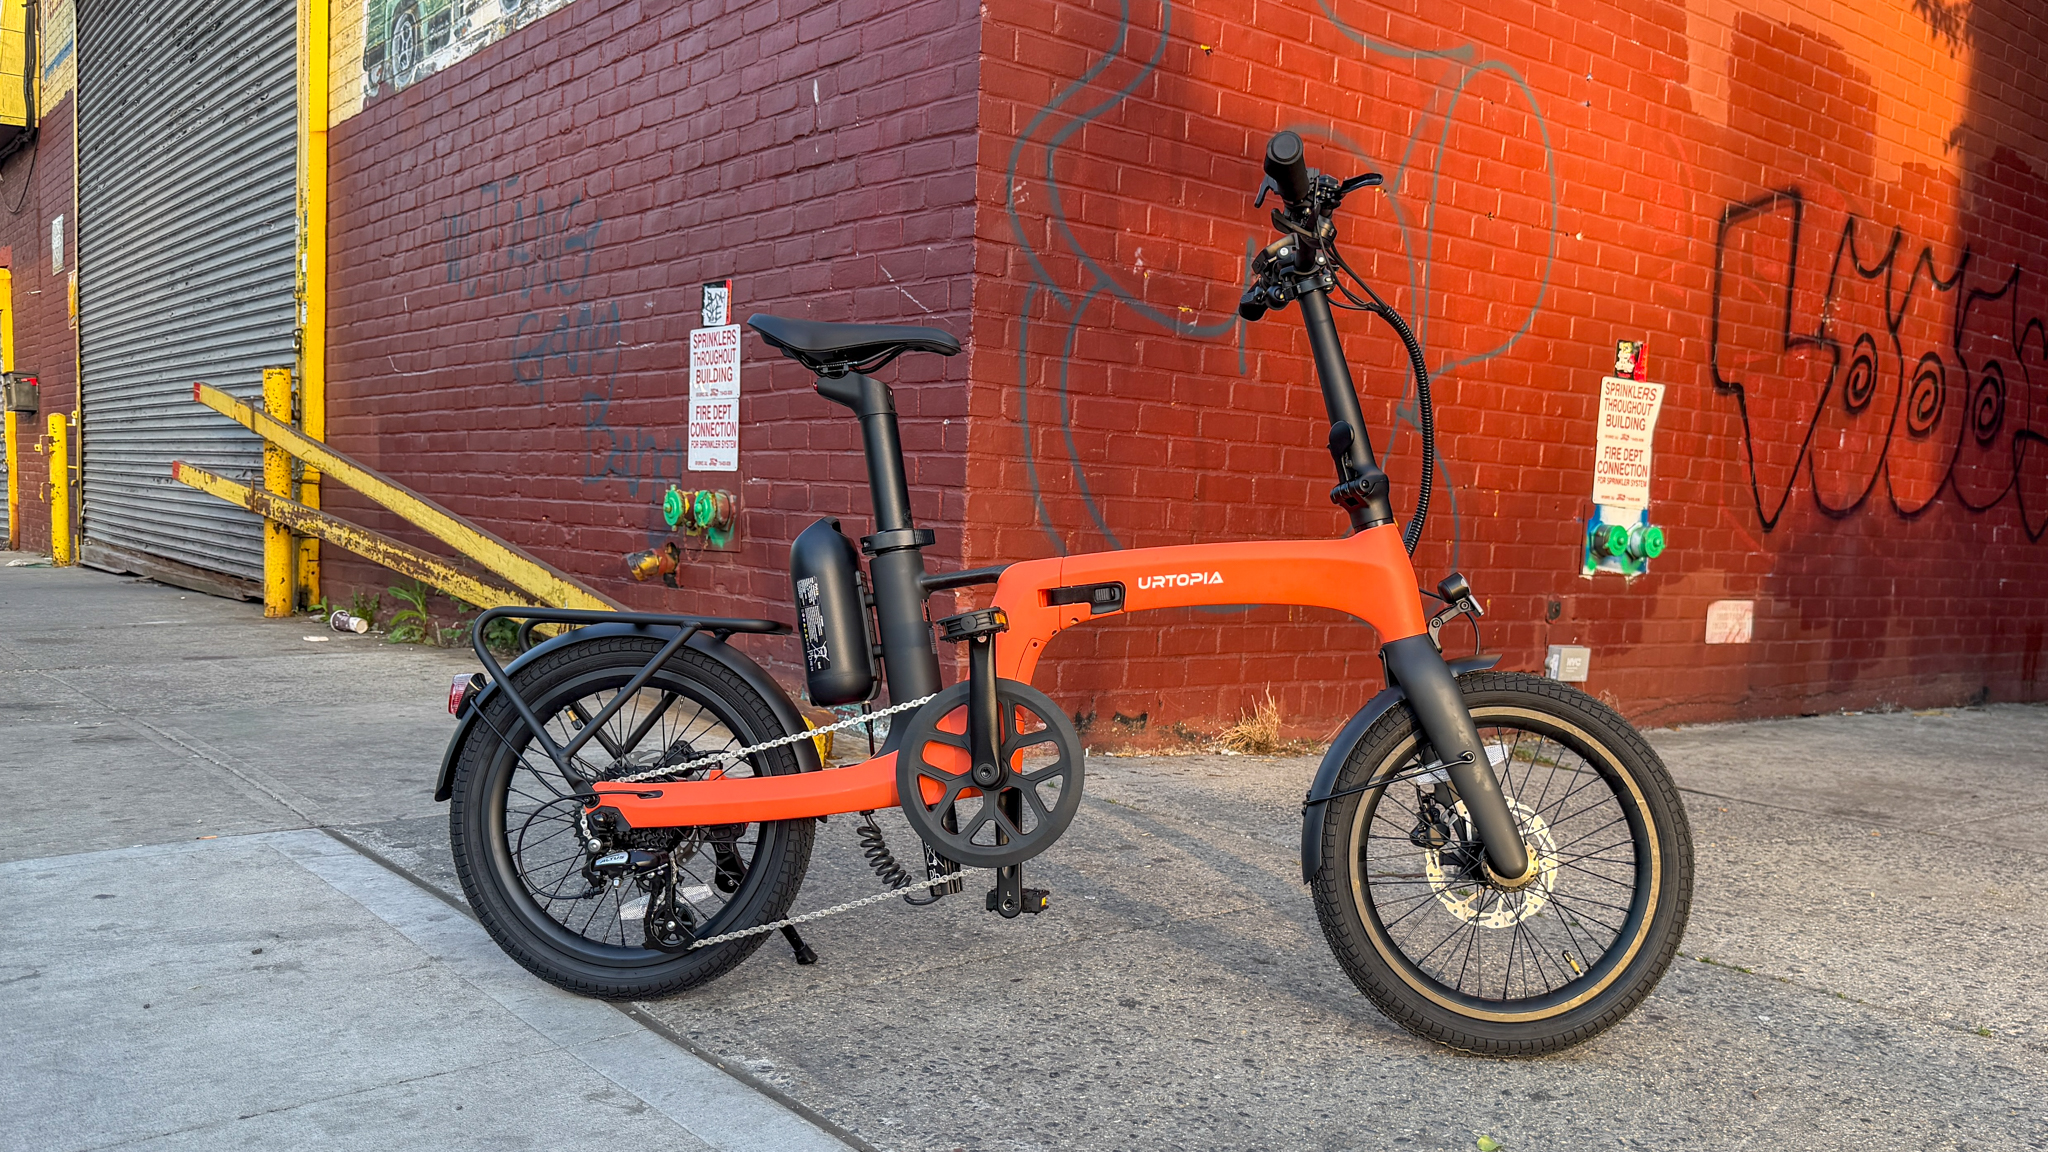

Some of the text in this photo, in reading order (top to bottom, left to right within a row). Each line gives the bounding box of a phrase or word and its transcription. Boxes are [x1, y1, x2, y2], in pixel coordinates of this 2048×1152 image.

[693, 329, 737, 349] SPRINKLERS
[693, 347, 737, 367] THROUGHOUT
[695, 366, 733, 384] BUILDING
[1605, 381, 1657, 402] SPRINKLERS
[695, 404, 732, 421] FIRE DEPT
[1604, 397, 1653, 417] THROUGHOUT
[690, 421, 737, 438] CONNECTION
[1605, 414, 1646, 431] BUILDING
[691, 440, 737, 449] FOR SPRINKLER SYSTEM
[1604, 446, 1644, 462] FIRE DEPT
[1597, 460, 1648, 478] CONNECTION
[1597, 476, 1647, 488] FOR SPRINKLER SYSTEM
[1138, 571, 1224, 589] URTOPIA
